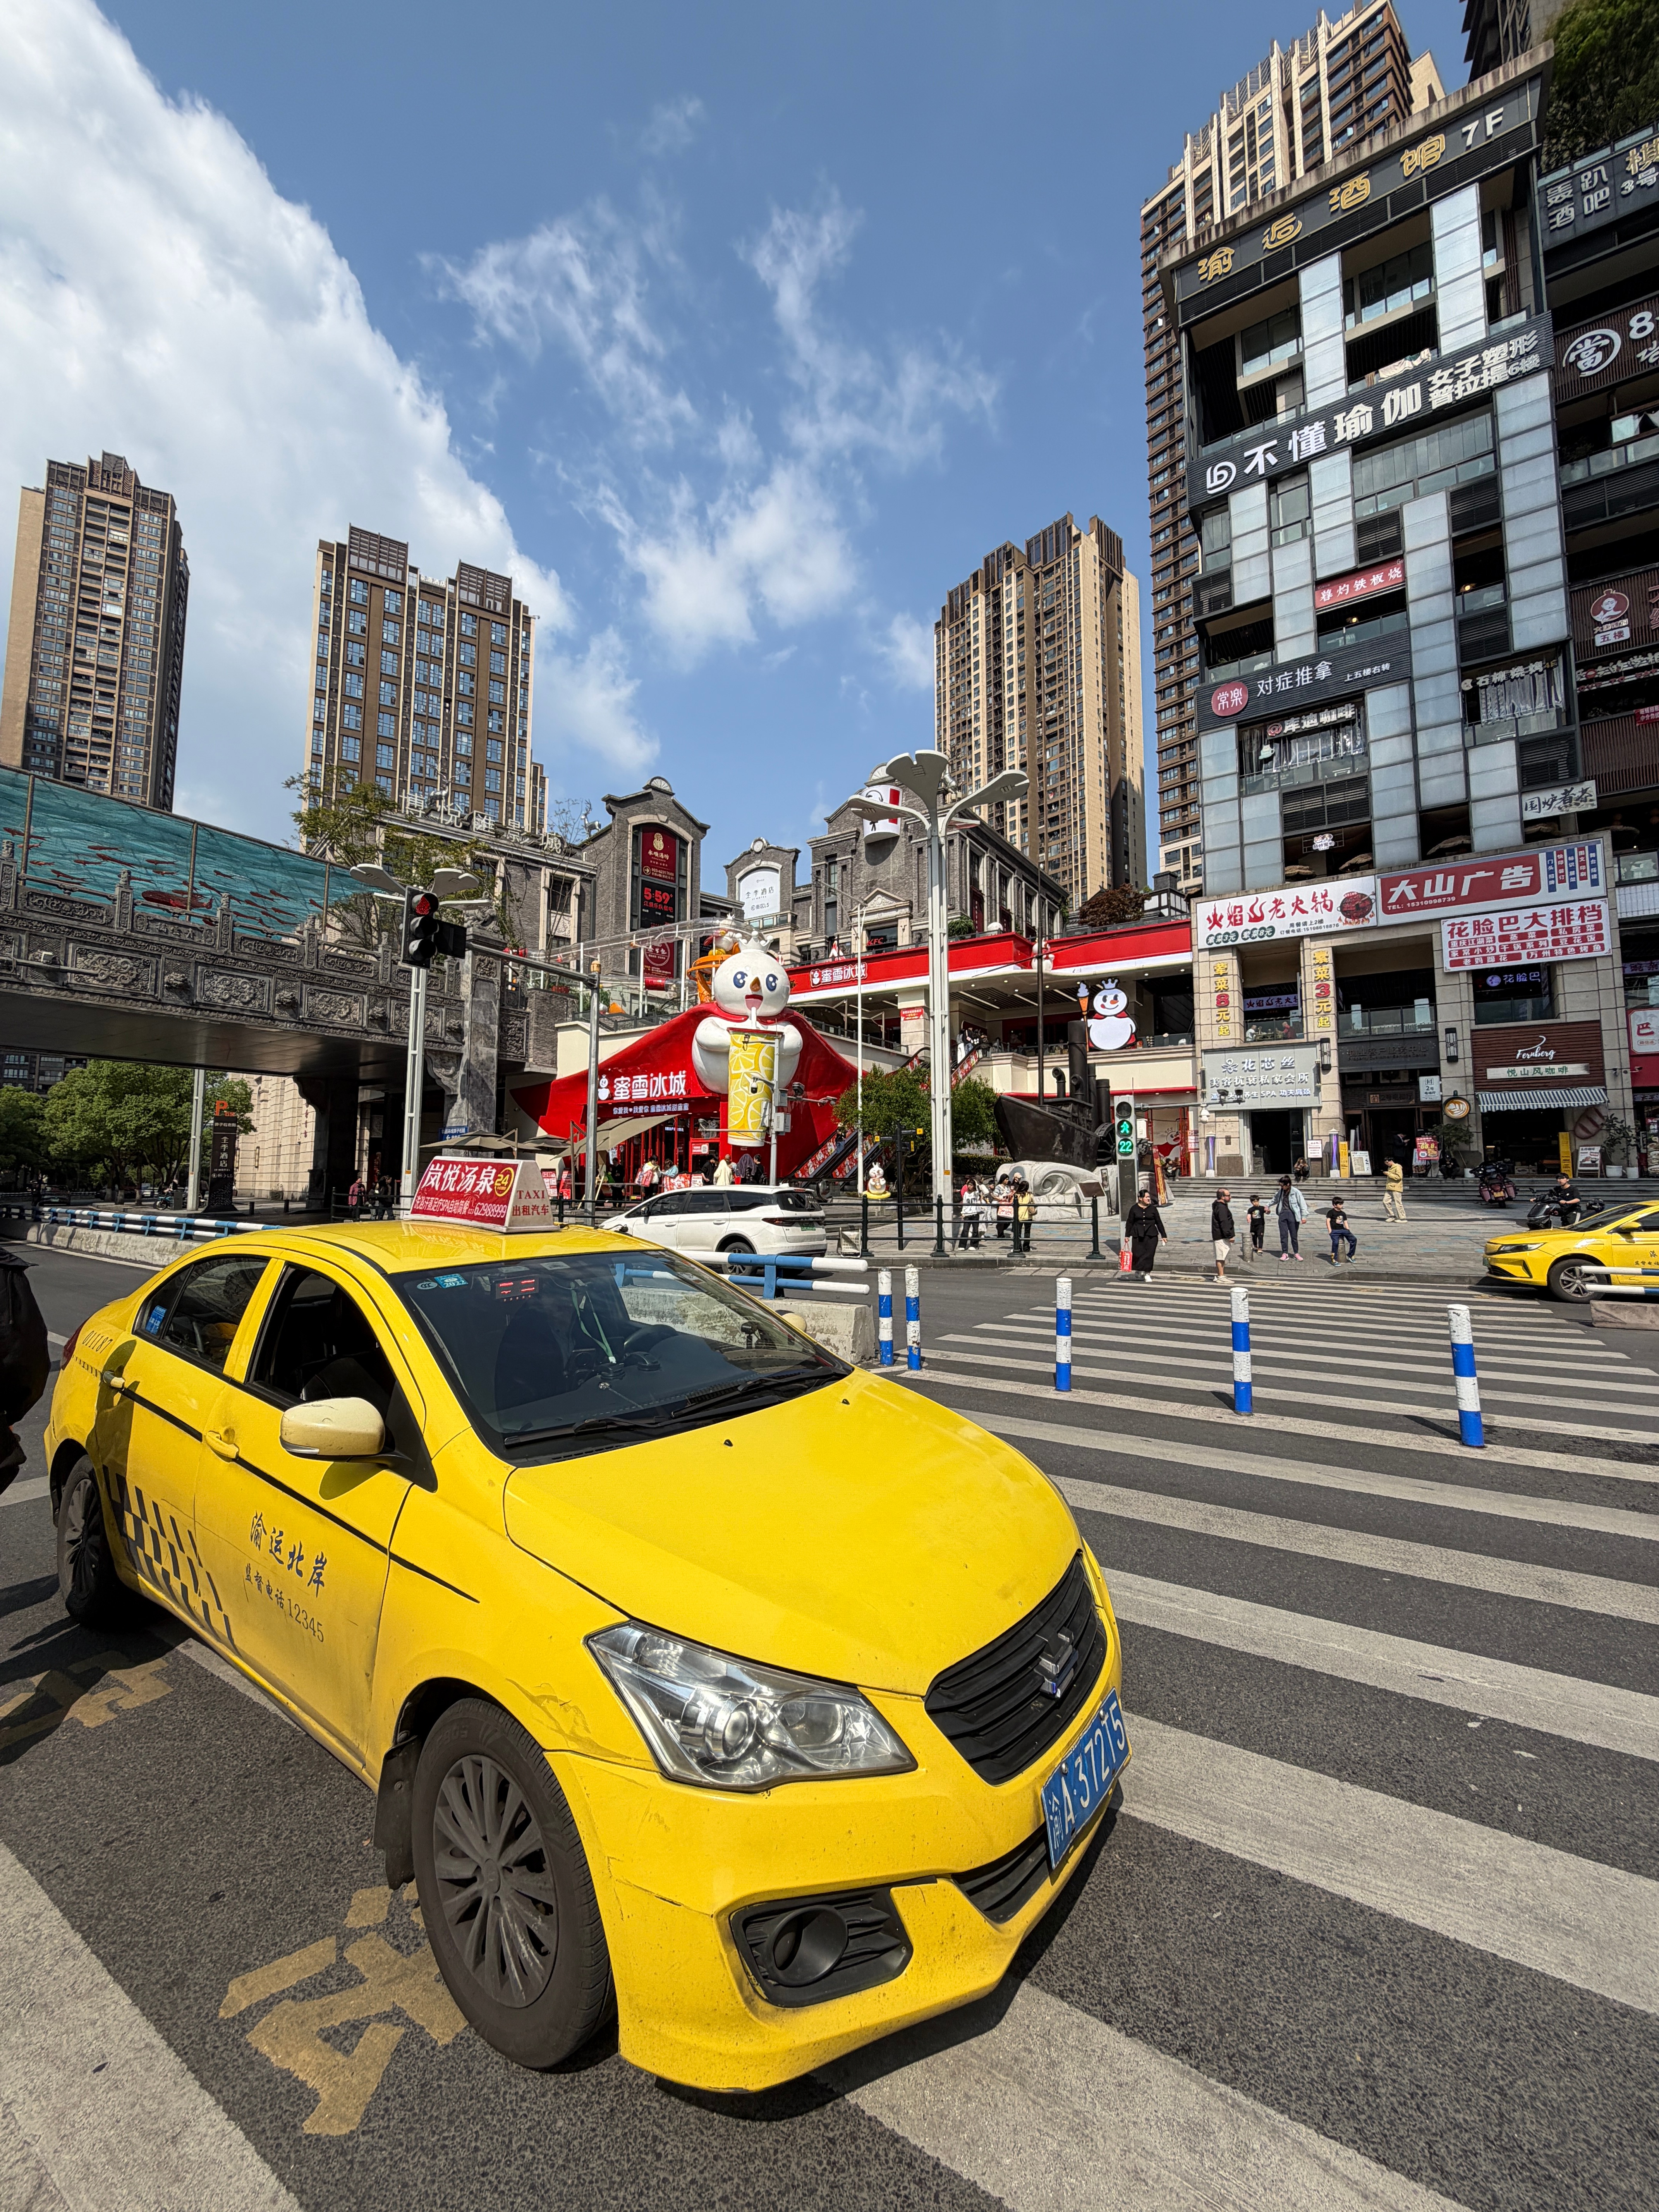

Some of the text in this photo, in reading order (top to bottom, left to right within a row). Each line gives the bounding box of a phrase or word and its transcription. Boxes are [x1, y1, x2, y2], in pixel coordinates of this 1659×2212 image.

[1198, 107, 1504, 281] 渝逅酒馆 7F
[1548, 187, 1610, 230] 酒吧
[1427, 330, 1539, 392] 女子塑形
[1508, 354, 1540, 376] 6楼
[1428, 361, 1509, 410] 普拉提
[1243, 382, 1422, 476] 不懂瑜伽
[1600, 629, 1624, 643] 五楼
[1257, 661, 1333, 697] 对症推拿
[1344, 663, 1391, 682] 上五楼右转
[1283, 703, 1355, 733] 库迪咖啡
[745, 886, 774, 899] 全季酒店
[1388, 865, 1534, 903] 大山广告
[1206, 889, 1333, 931] 火焰山老火锅
[1448, 904, 1602, 939] 花脸巴大排档
[1450, 924, 1595, 948] 重庆江湖菜 蒸菜 私房菜
[1451, 935, 1596, 957] 家常小炒 干锅系列 豆花饭
[1463, 944, 1602, 965] 老妈蹄花 万州特色烤鱼
[821, 963, 866, 983] 蜜雪冰城
[1503, 972, 1541, 984] 花脸巴
[1213, 962, 1231, 1036] 荤菜8元起
[1313, 950, 1332, 1028] 素菜3元起
[1242, 1056, 1295, 1072] 花芯丝
[1507, 1066, 1569, 1077] 悦山风咖啡
[613, 1070, 687, 1100] 蜜雪冰城
[1210, 1072, 1309, 1088] 美容抗衰私家会所
[215, 1100, 228, 1116] P
[220, 1136, 229, 1167] 全季酒店
[1119, 1141, 1132, 1152] 22
[422, 1163, 510, 1195] 岚悦汤泉 24
[517, 1190, 544, 1199] TAXI
[474, 1202, 507, 1218] 62988999
[512, 1204, 549, 1216] 出租汽车
[251, 1510, 327, 1598] 渝运北岸
